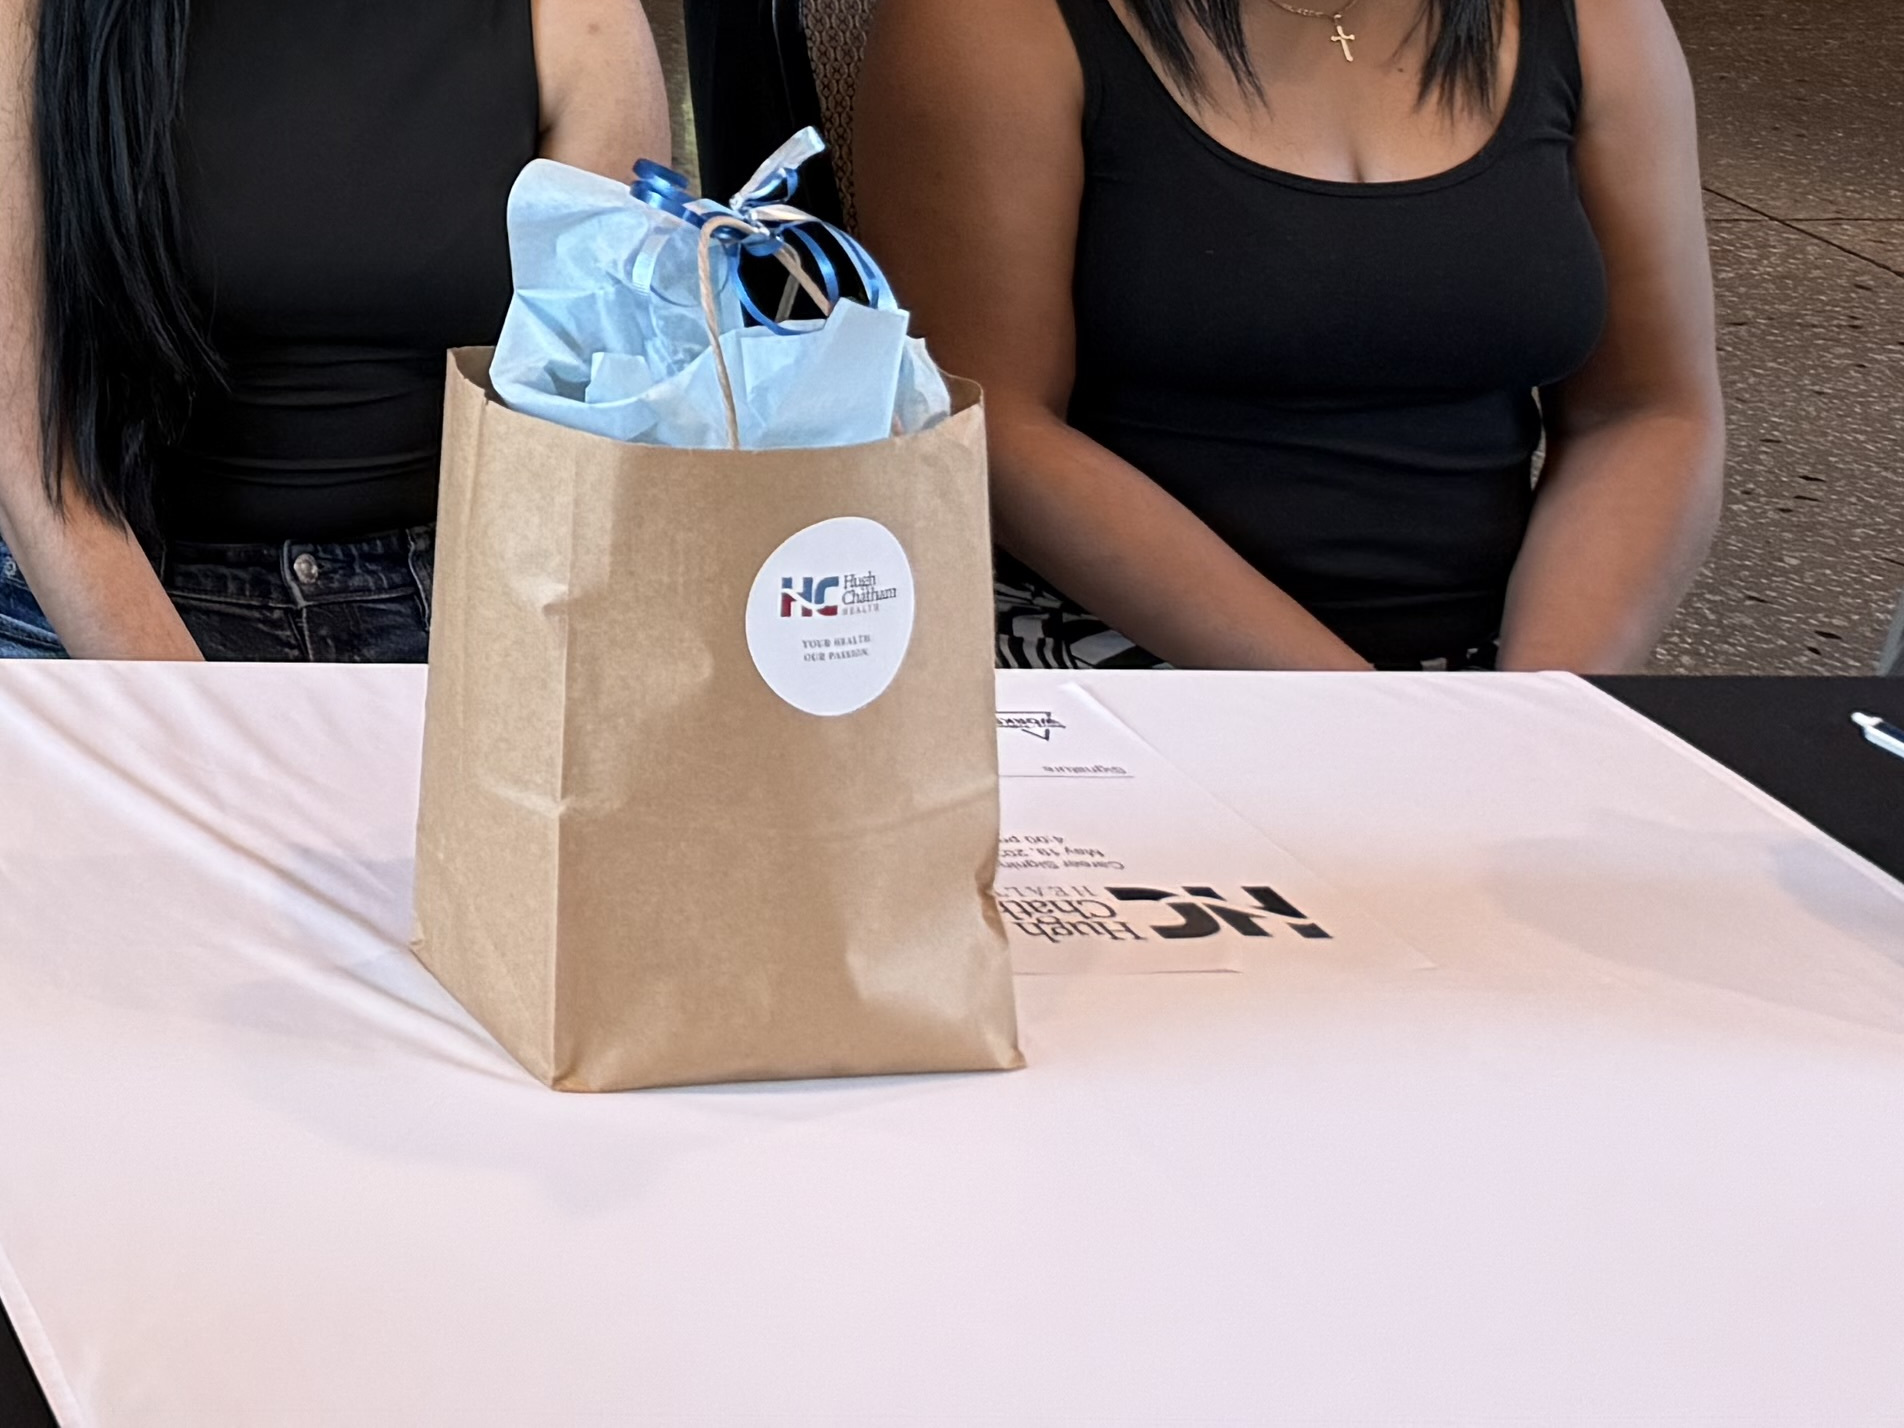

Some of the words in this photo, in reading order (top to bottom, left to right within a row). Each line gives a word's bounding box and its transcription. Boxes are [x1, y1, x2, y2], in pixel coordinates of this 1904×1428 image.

[843, 570, 877, 590] Hugh
[780, 576, 840, 617] HC
[842, 587, 897, 605] Chatham
[842, 603, 880, 616] HEALTH
[801, 638, 831, 649] YOUR
[803, 652, 826, 662] OUR
[1042, 765, 1127, 774] Signature
[1024, 835, 1064, 844] 4:00
[1064, 846, 1105, 857] May
[998, 860, 1060, 870] Signin
[1063, 860, 1125, 870] Career
[995, 885, 1098, 897] HEAL
[1103, 886, 1334, 940] HC
[1011, 915, 1148, 943] Hugh
